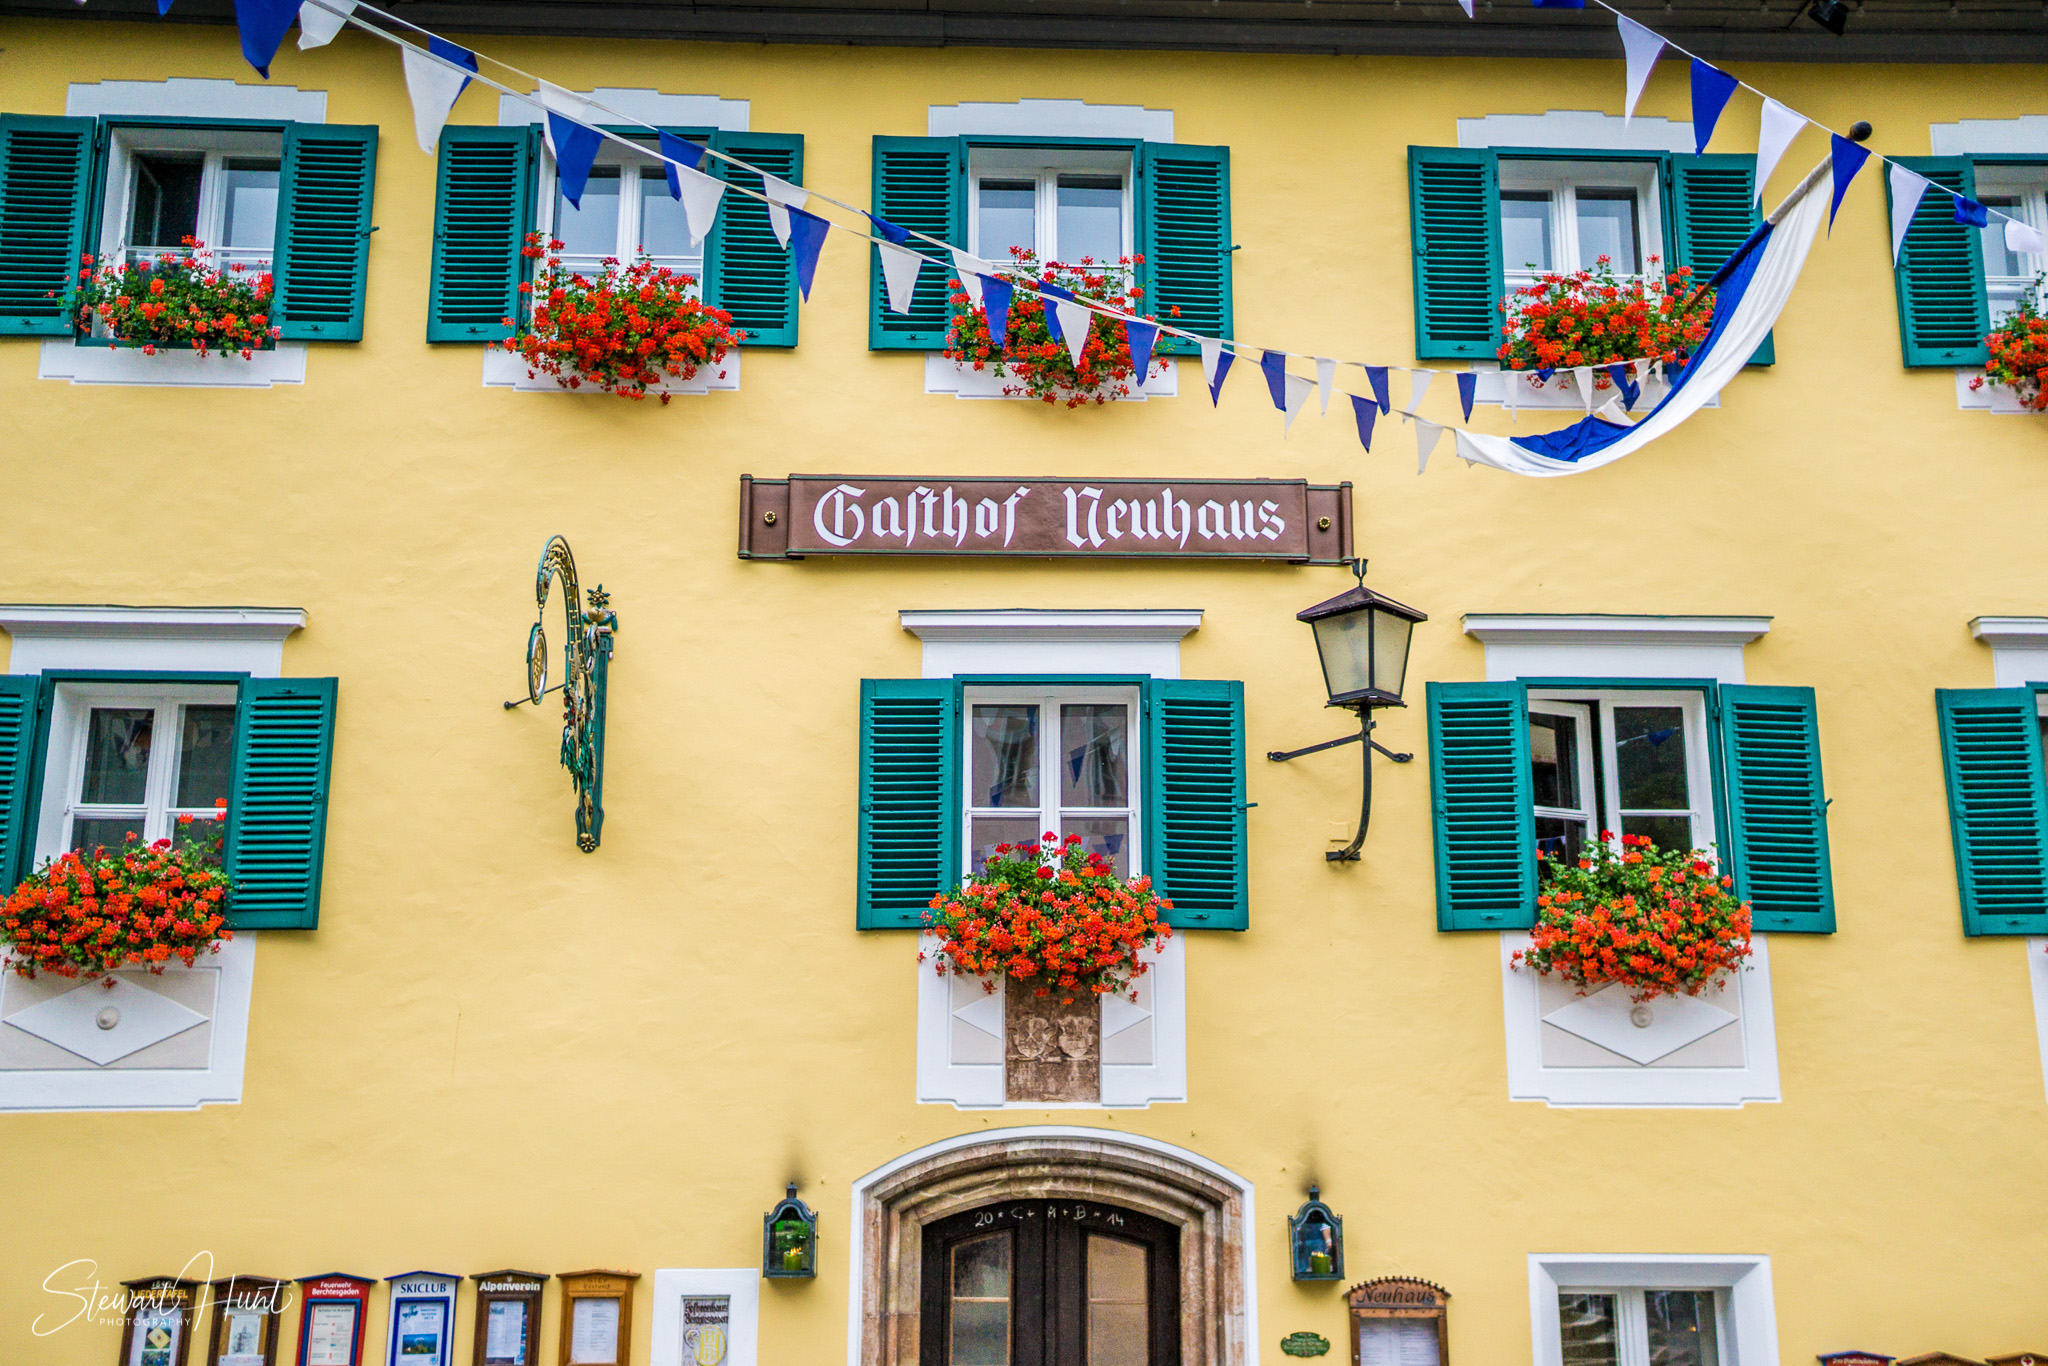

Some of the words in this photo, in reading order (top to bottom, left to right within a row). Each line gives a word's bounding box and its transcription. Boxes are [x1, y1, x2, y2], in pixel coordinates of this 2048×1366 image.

[1062, 485, 1287, 550] Neuhaus
[974, 1211, 994, 1227] 20
[1106, 1213, 1125, 1227] 14
[320, 1281, 352, 1289] Feuerwehr
[400, 1282, 447, 1294] SKICLUB
[479, 1281, 541, 1293] Alpenverein
[311, 1287, 360, 1298] Berchtesgaden
[1357, 1286, 1435, 1304] Neuhaus
